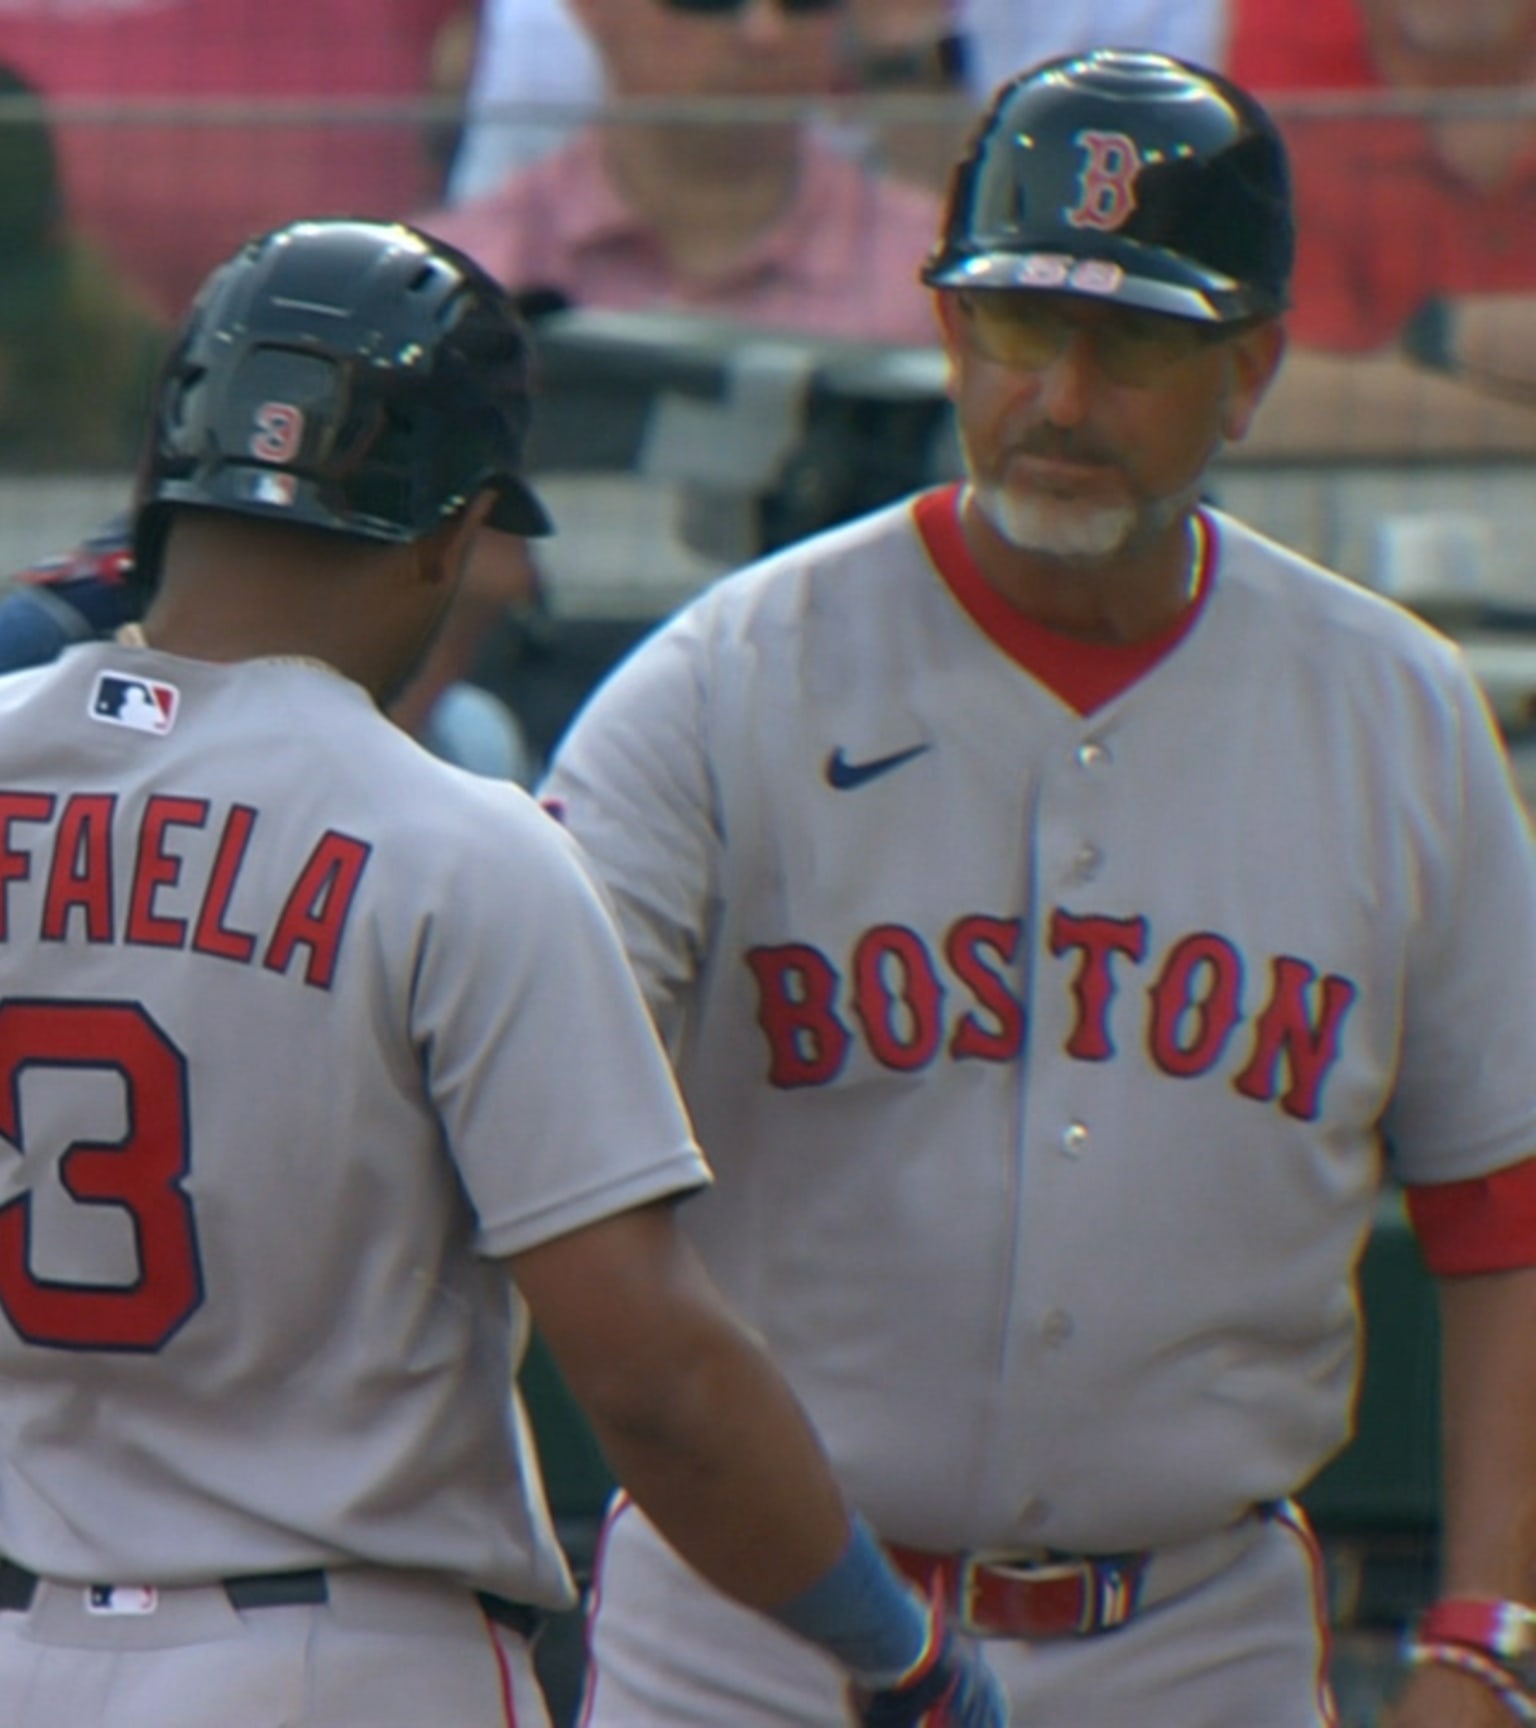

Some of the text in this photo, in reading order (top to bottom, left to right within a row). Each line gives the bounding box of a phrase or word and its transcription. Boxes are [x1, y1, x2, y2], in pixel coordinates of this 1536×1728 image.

[1066, 130, 1140, 231] B
[252, 402, 302, 463] 3
[745, 908, 1357, 1121] BOSTON
